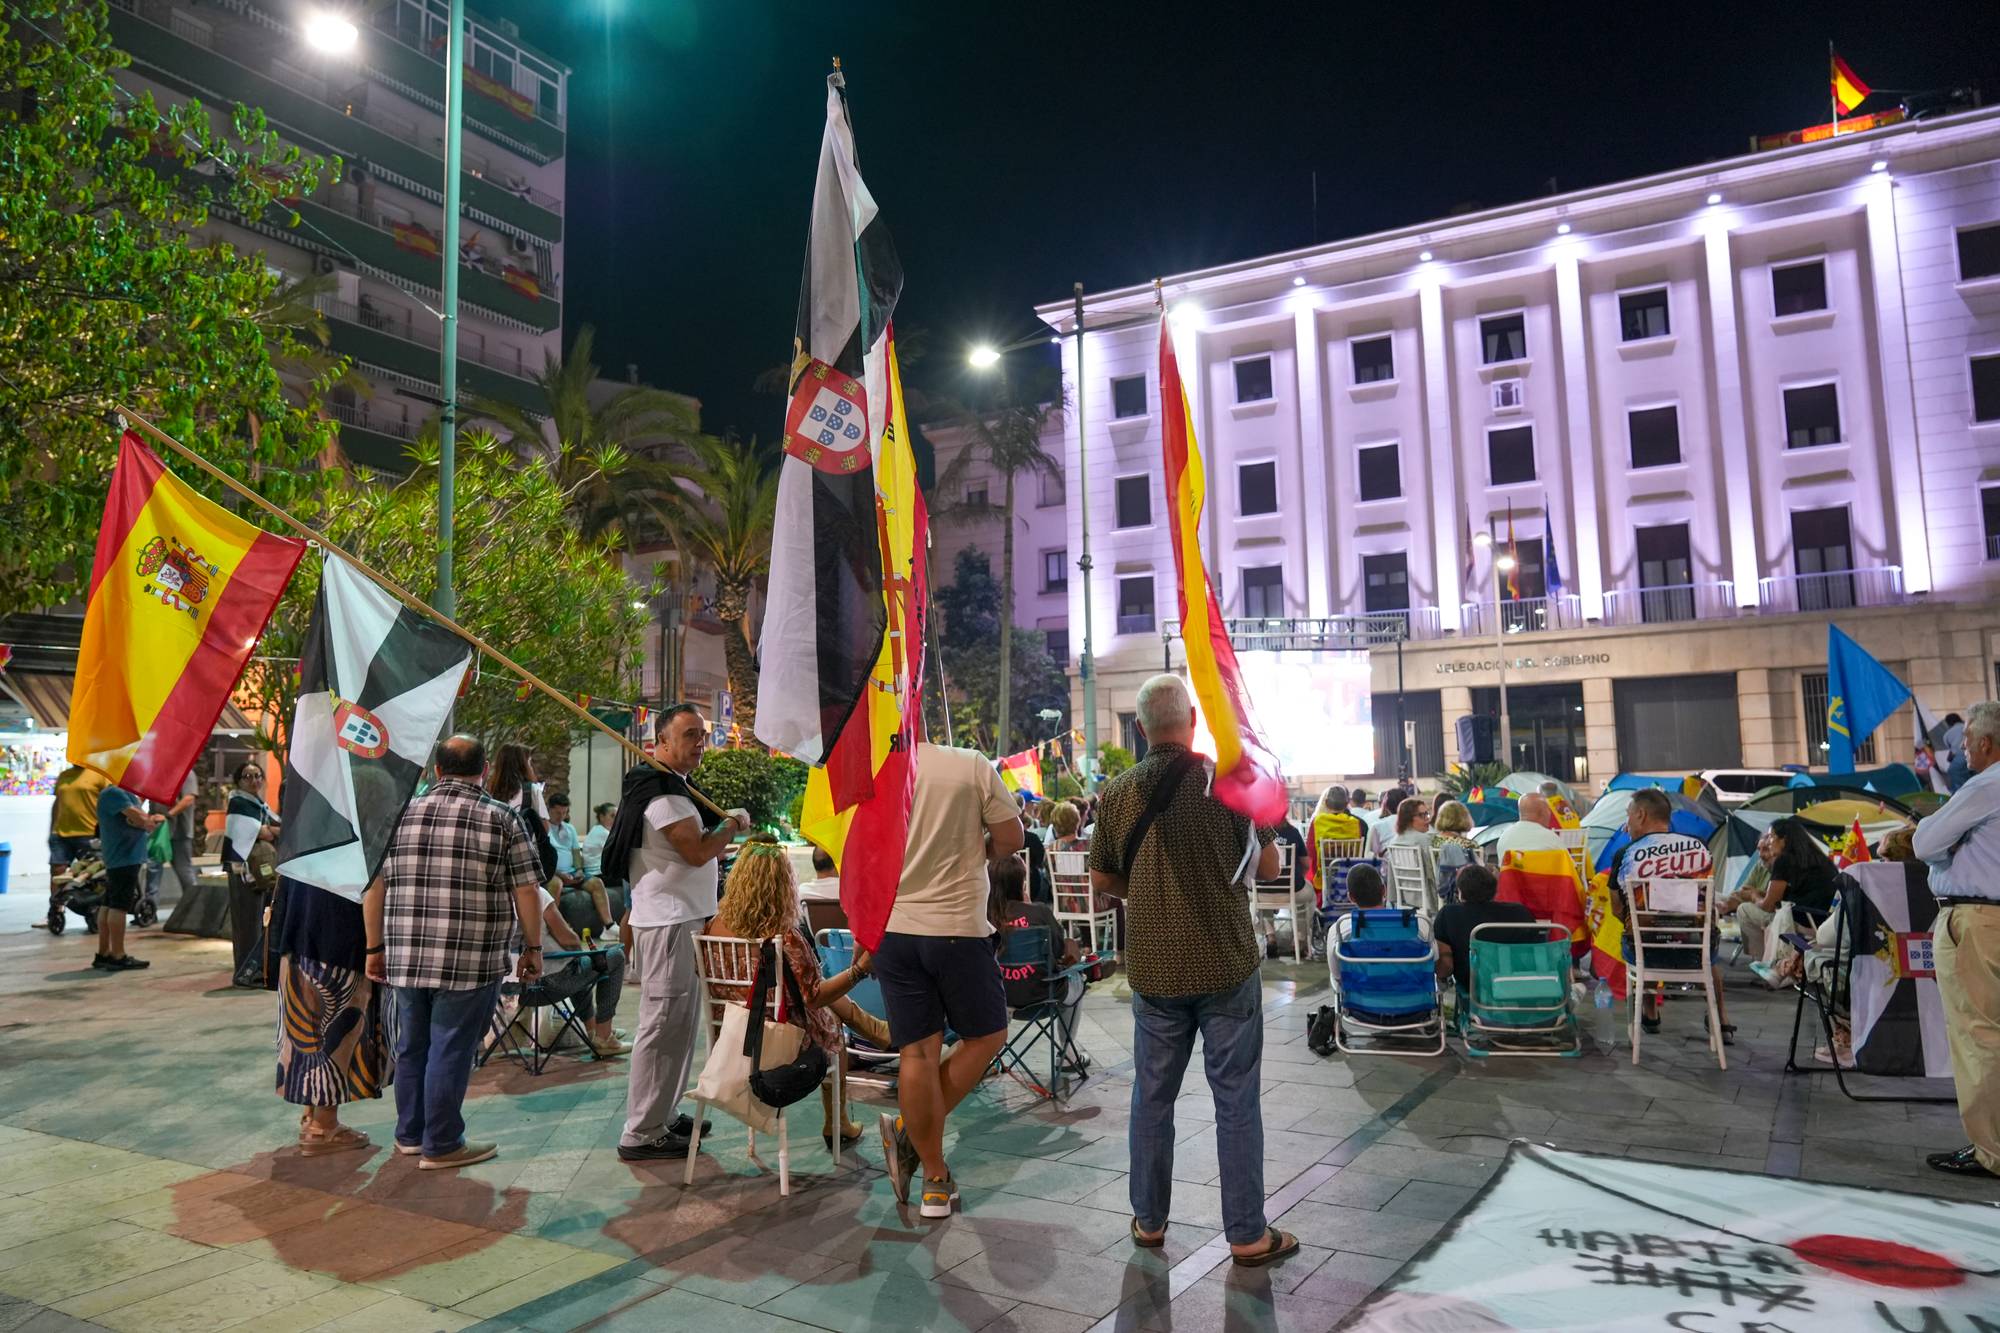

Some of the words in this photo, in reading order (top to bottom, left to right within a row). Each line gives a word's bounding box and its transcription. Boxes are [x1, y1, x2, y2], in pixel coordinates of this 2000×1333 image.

[1515, 657, 1539, 668] DEL
[1543, 653, 1611, 667] GOBIERNO
[722, 695, 731, 716] P
[1634, 840, 1701, 861] ORGULLO
